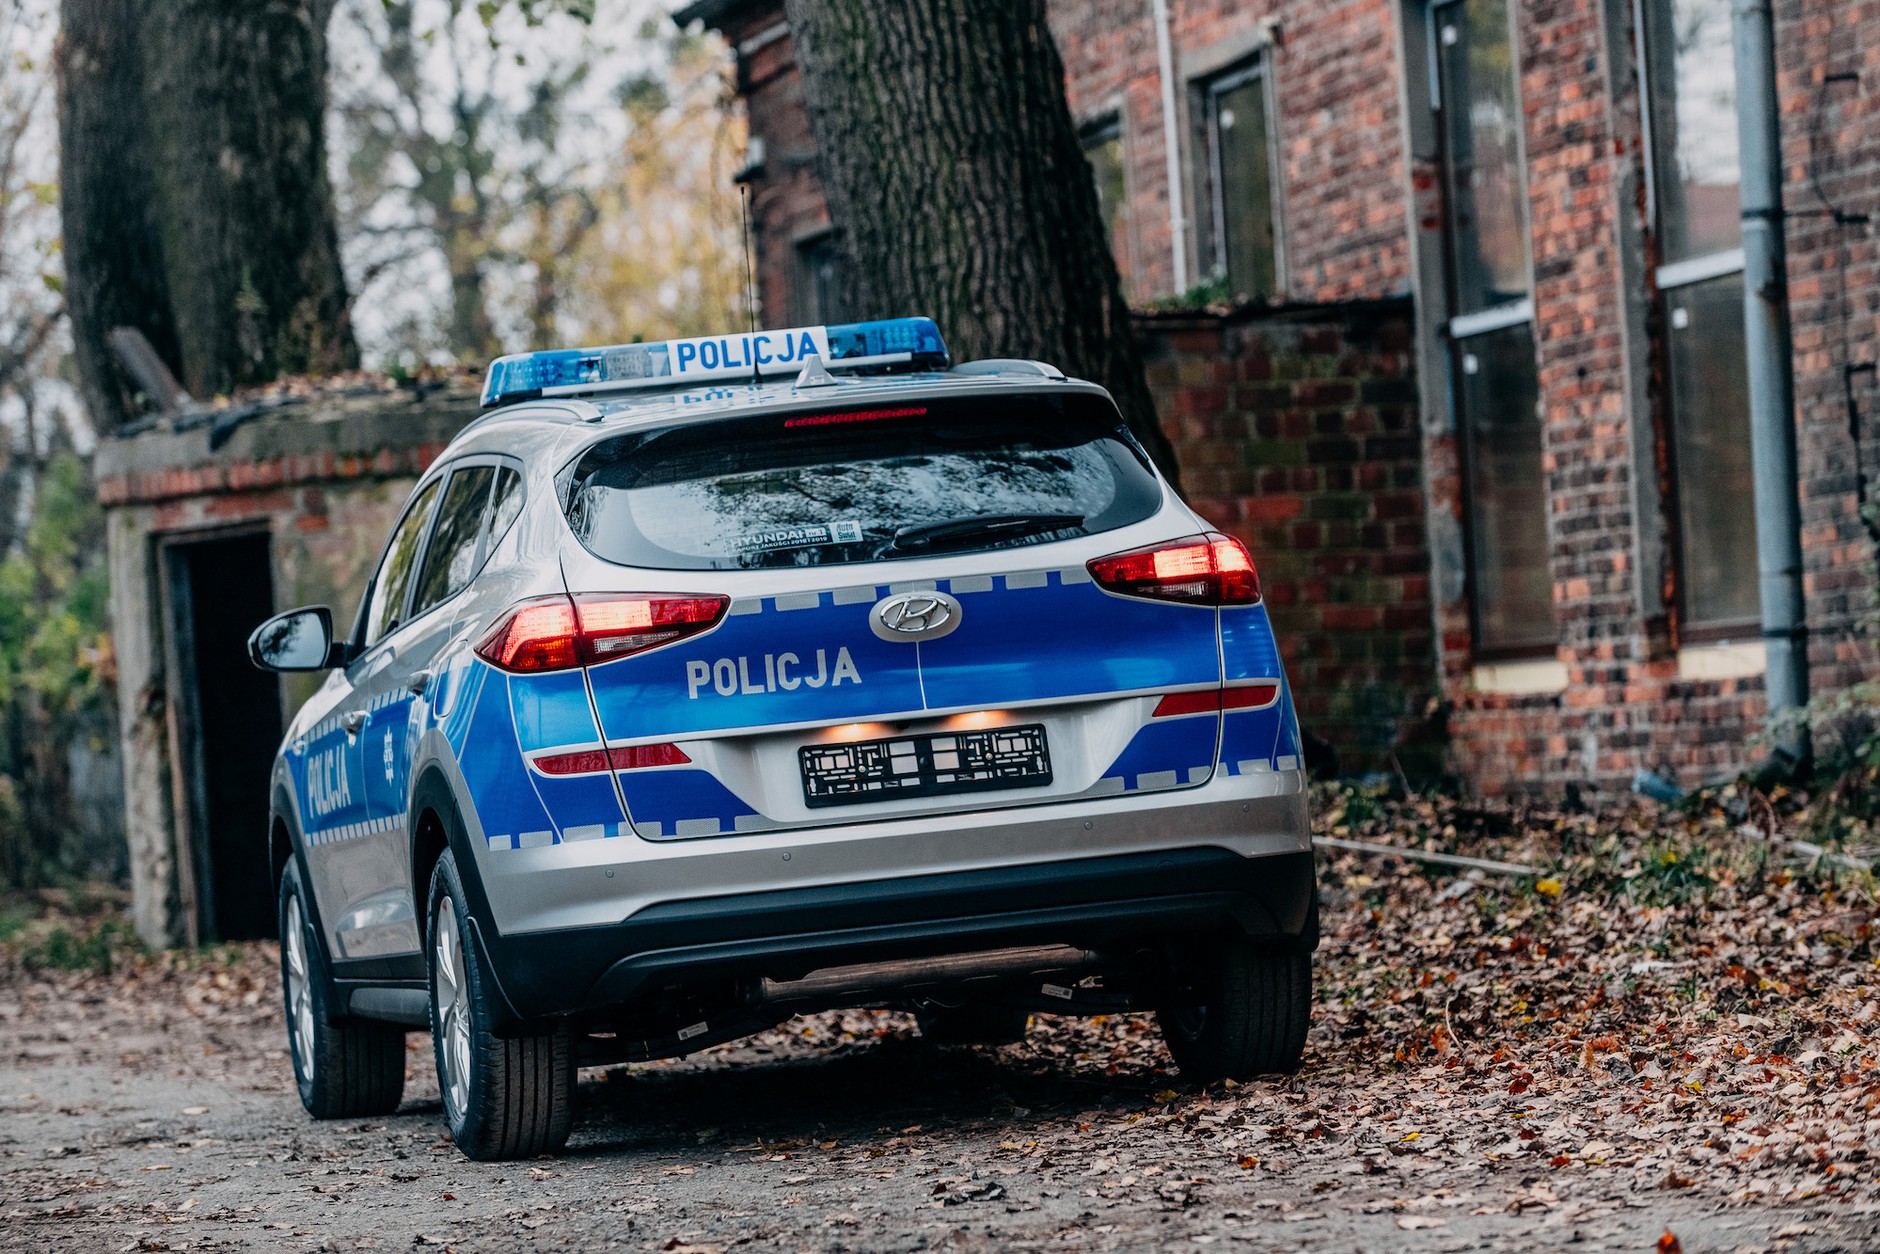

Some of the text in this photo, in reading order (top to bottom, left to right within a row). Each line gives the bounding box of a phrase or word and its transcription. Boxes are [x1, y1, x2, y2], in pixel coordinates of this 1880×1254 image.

[677, 331, 819, 372] POLICJA
[730, 530, 804, 547] HYUNDAI
[686, 646, 862, 700] POLICJA
[308, 743, 352, 819] POLICJA
